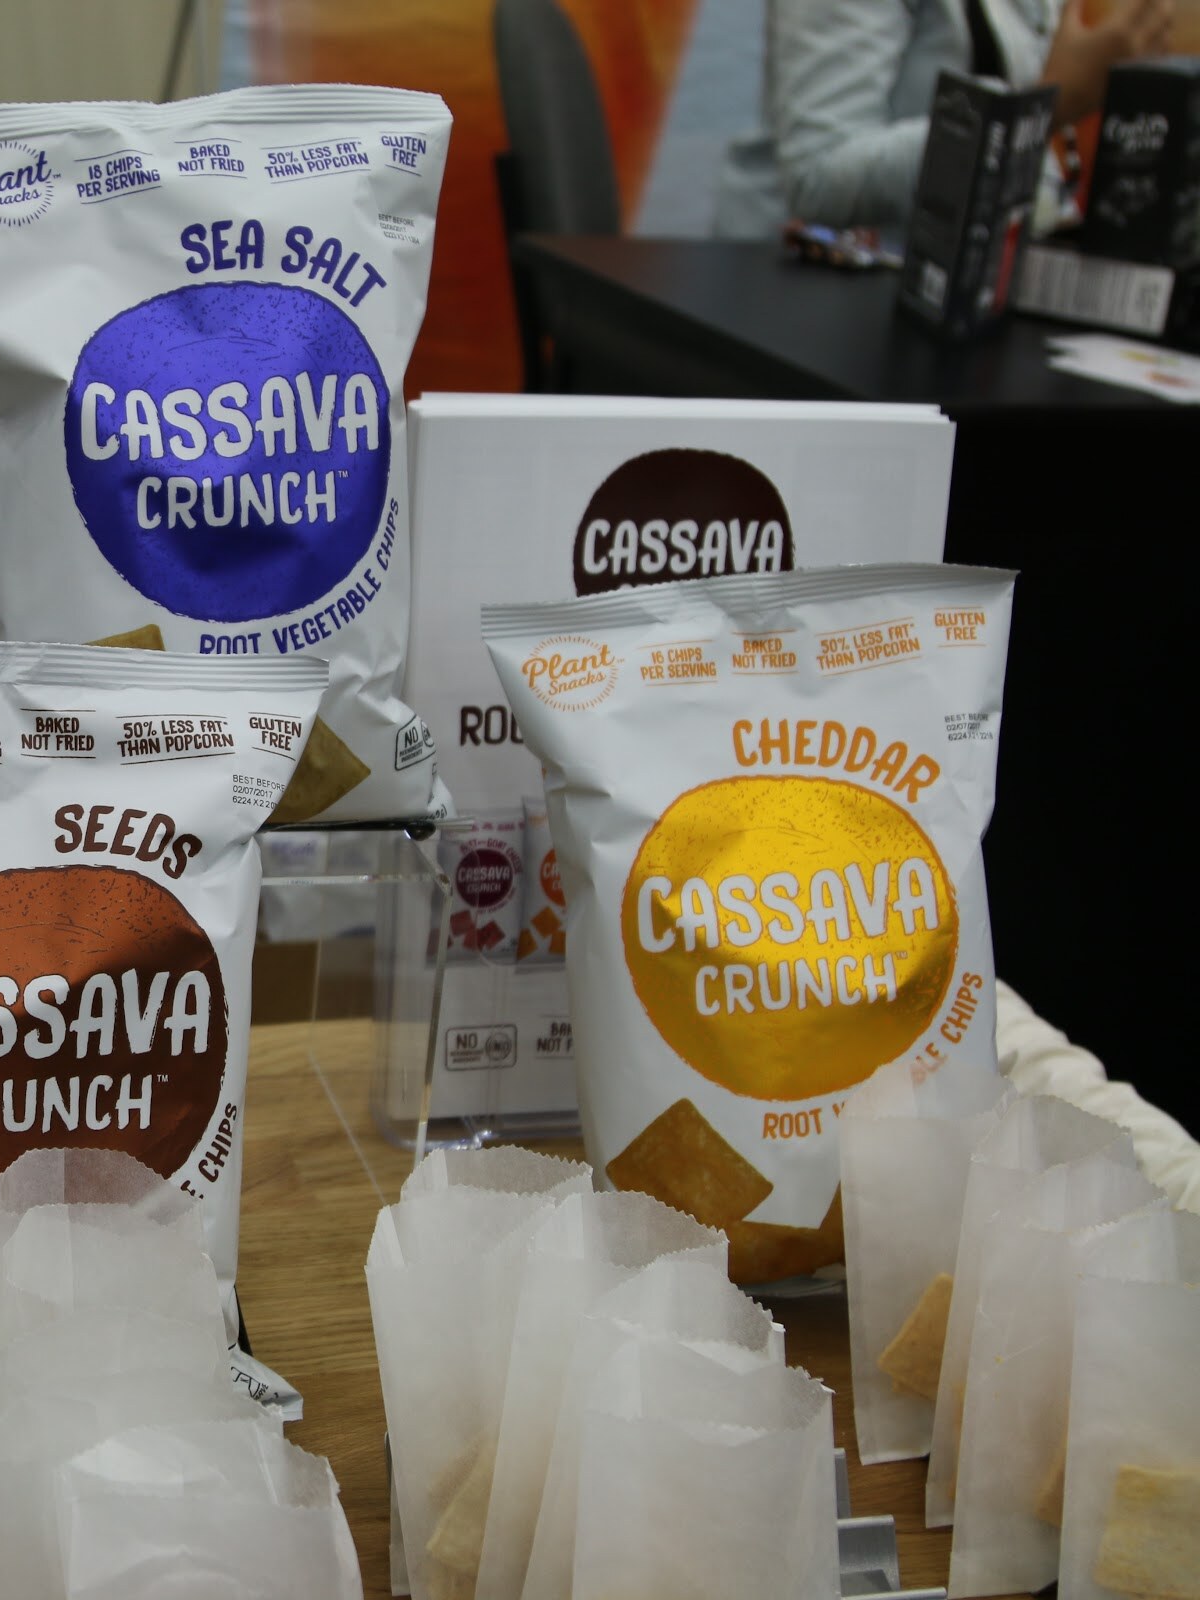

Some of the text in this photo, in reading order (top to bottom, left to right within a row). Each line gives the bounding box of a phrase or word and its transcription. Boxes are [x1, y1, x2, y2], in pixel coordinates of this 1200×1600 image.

[189, 144, 230, 159] BAKED
[267, 151, 299, 165] 50%
[301, 146, 332, 161] LESS
[381, 135, 427, 155] GLUTEN
[88, 156, 143, 180] 18 CHIPS
[177, 157, 245, 173] NOT FRIED
[264, 152, 369, 179] THAN POPCORN
[392, 149, 418, 168] FREE
[76, 169, 161, 198] PER SERVING
[180, 218, 387, 308] SEA SALT
[80, 370, 379, 462] CASSAVA
[136, 470, 337, 529] CRUNCH
[582, 518, 784, 576] CASSAVA
[199, 497, 399, 655] ROOT VEGETABLE CHIPS
[934, 612, 986, 627] GLUTEN
[820, 637, 850, 653] 50%
[853, 630, 884, 648] LESS
[945, 626, 977, 641] FREE
[667, 647, 702, 663] CHIPS
[743, 638, 782, 653] BAKED
[816, 638, 920, 671] THAN POPCORN
[521, 644, 615, 689] Plant
[732, 652, 796, 668] NOT FRIED
[640, 661, 717, 681] PER SERVING
[548, 671, 606, 697] Snacks
[35, 716, 80, 733] BAKED
[249, 717, 302, 738] GLUTEN
[944, 713, 966, 723] BEST
[123, 721, 157, 739] 50%
[161, 720, 194, 735] LESS
[404, 726, 419, 748] NO
[21, 733, 95, 751] NOT FRIED
[117, 733, 235, 757] THAN POPCORN
[261, 730, 292, 751] FREE
[732, 718, 941, 804] CHEDDAR
[232, 774, 285, 792] BEST BEFORE
[232, 785, 273, 798] 02/07/2017
[232, 795, 251, 805] 6224
[54, 804, 202, 879] SEEDS
[458, 865, 510, 883] CASSAVA
[637, 856, 940, 953] CASSAVA
[695, 952, 898, 1016] CRUNCH
[940, 971, 983, 1045] CHIPS
[456, 1032, 478, 1049] NO
[536, 1038, 562, 1052] NOT
[762, 1109, 822, 1139] ROOT
[198, 1102, 238, 1184] CHIPS
